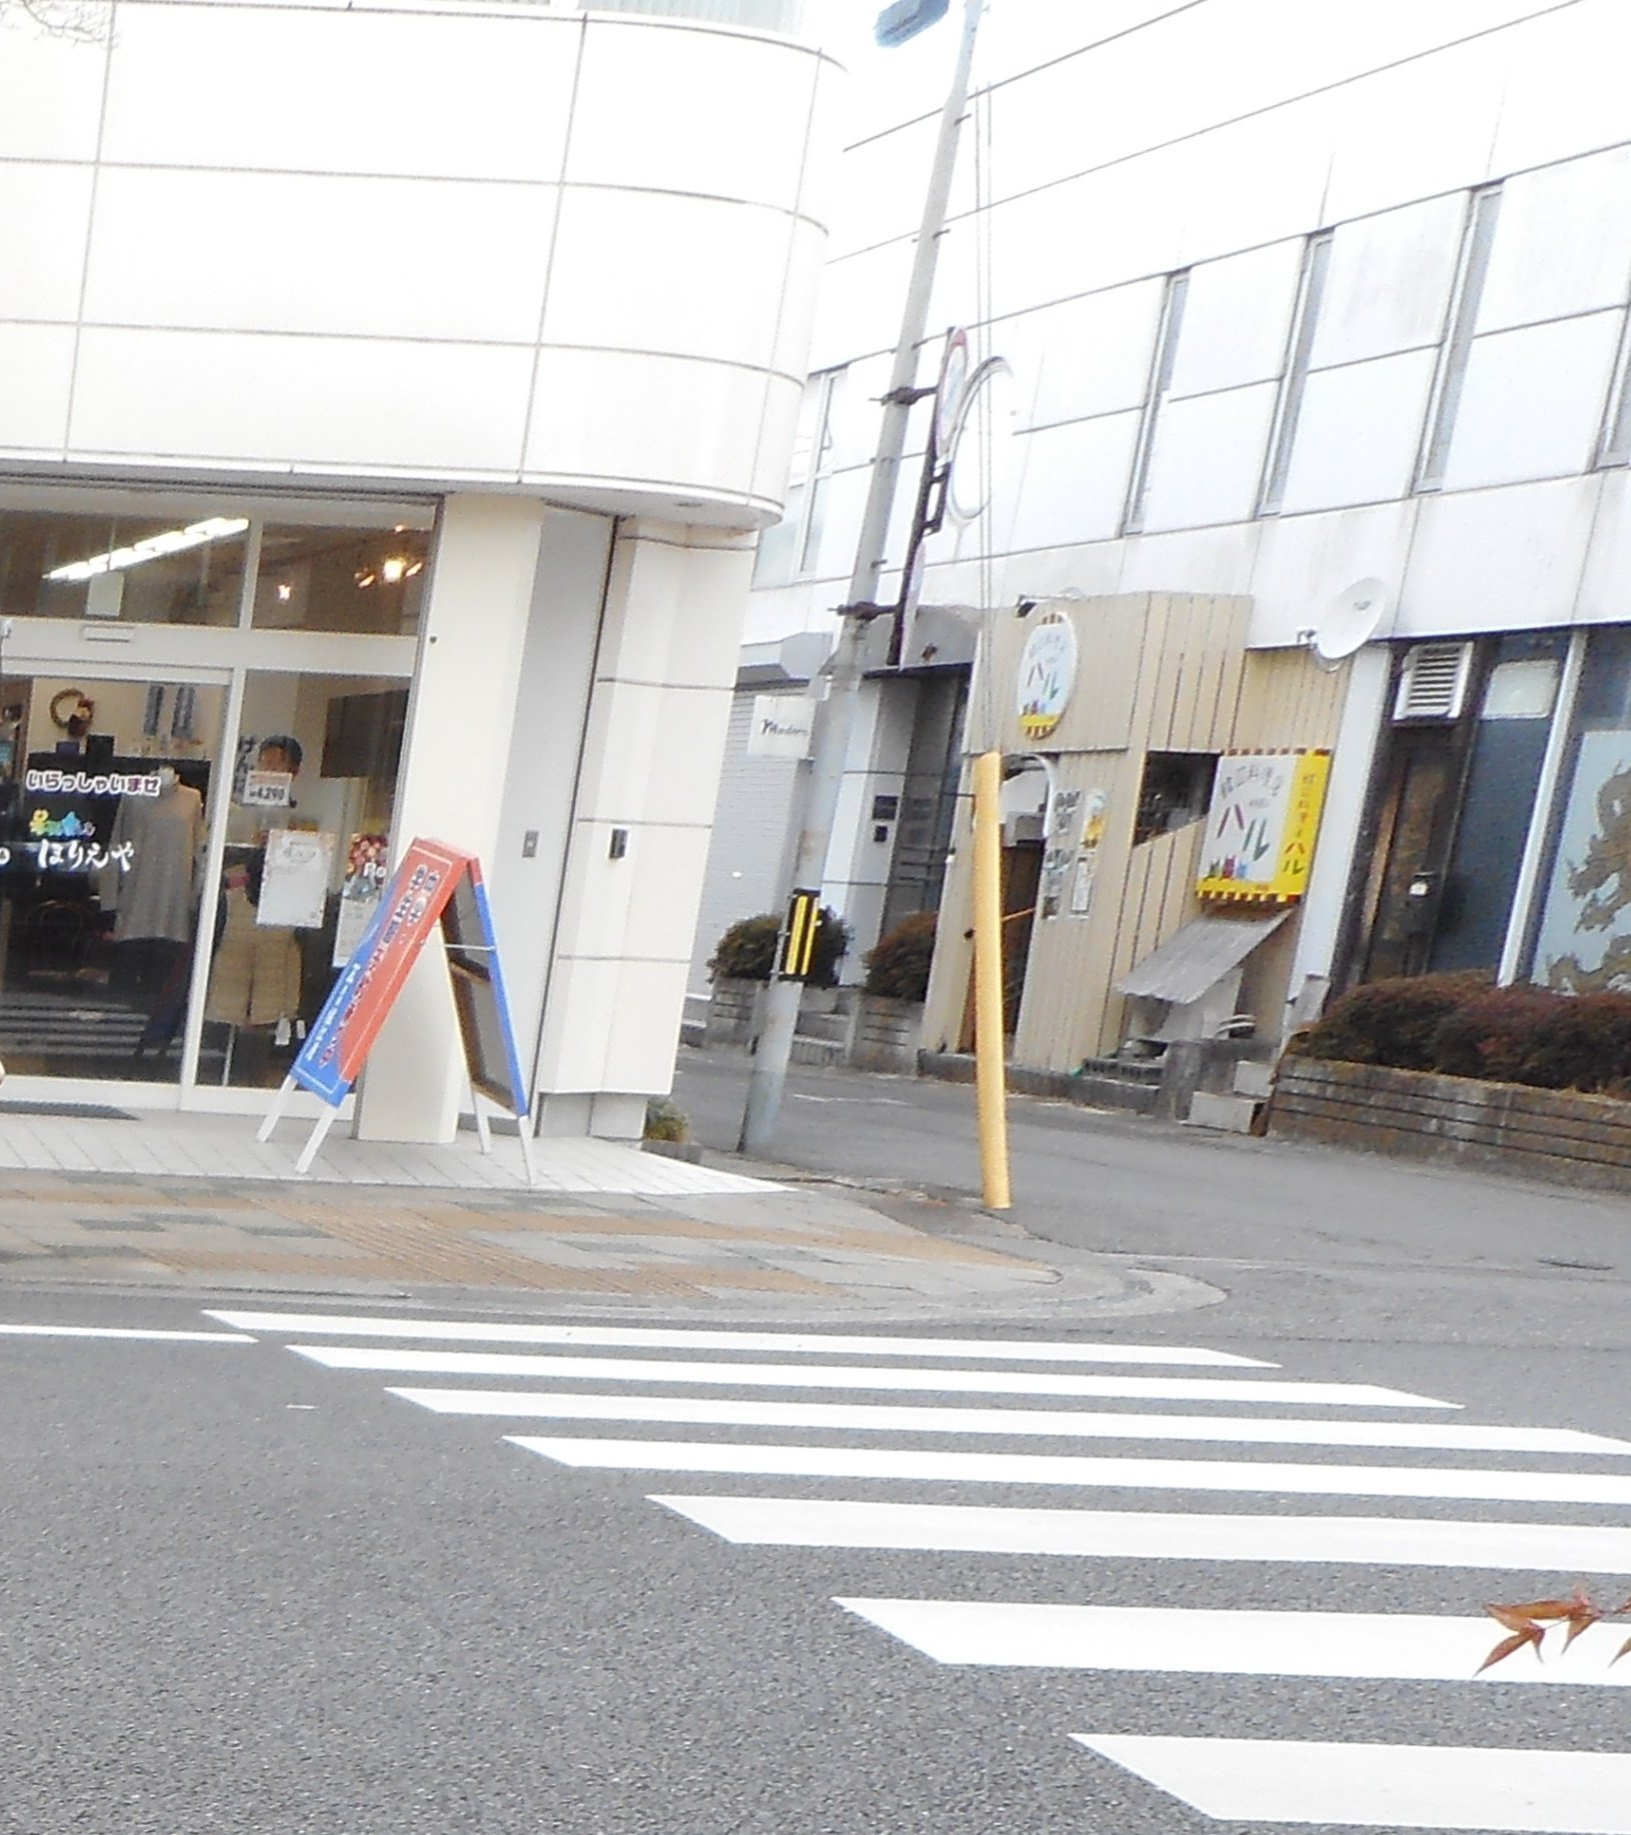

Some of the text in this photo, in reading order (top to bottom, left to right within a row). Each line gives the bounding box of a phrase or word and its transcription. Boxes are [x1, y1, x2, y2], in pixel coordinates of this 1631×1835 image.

[26, 769, 161, 796] いらっしゃいませ
[38, 838, 135, 872] ほりえや
